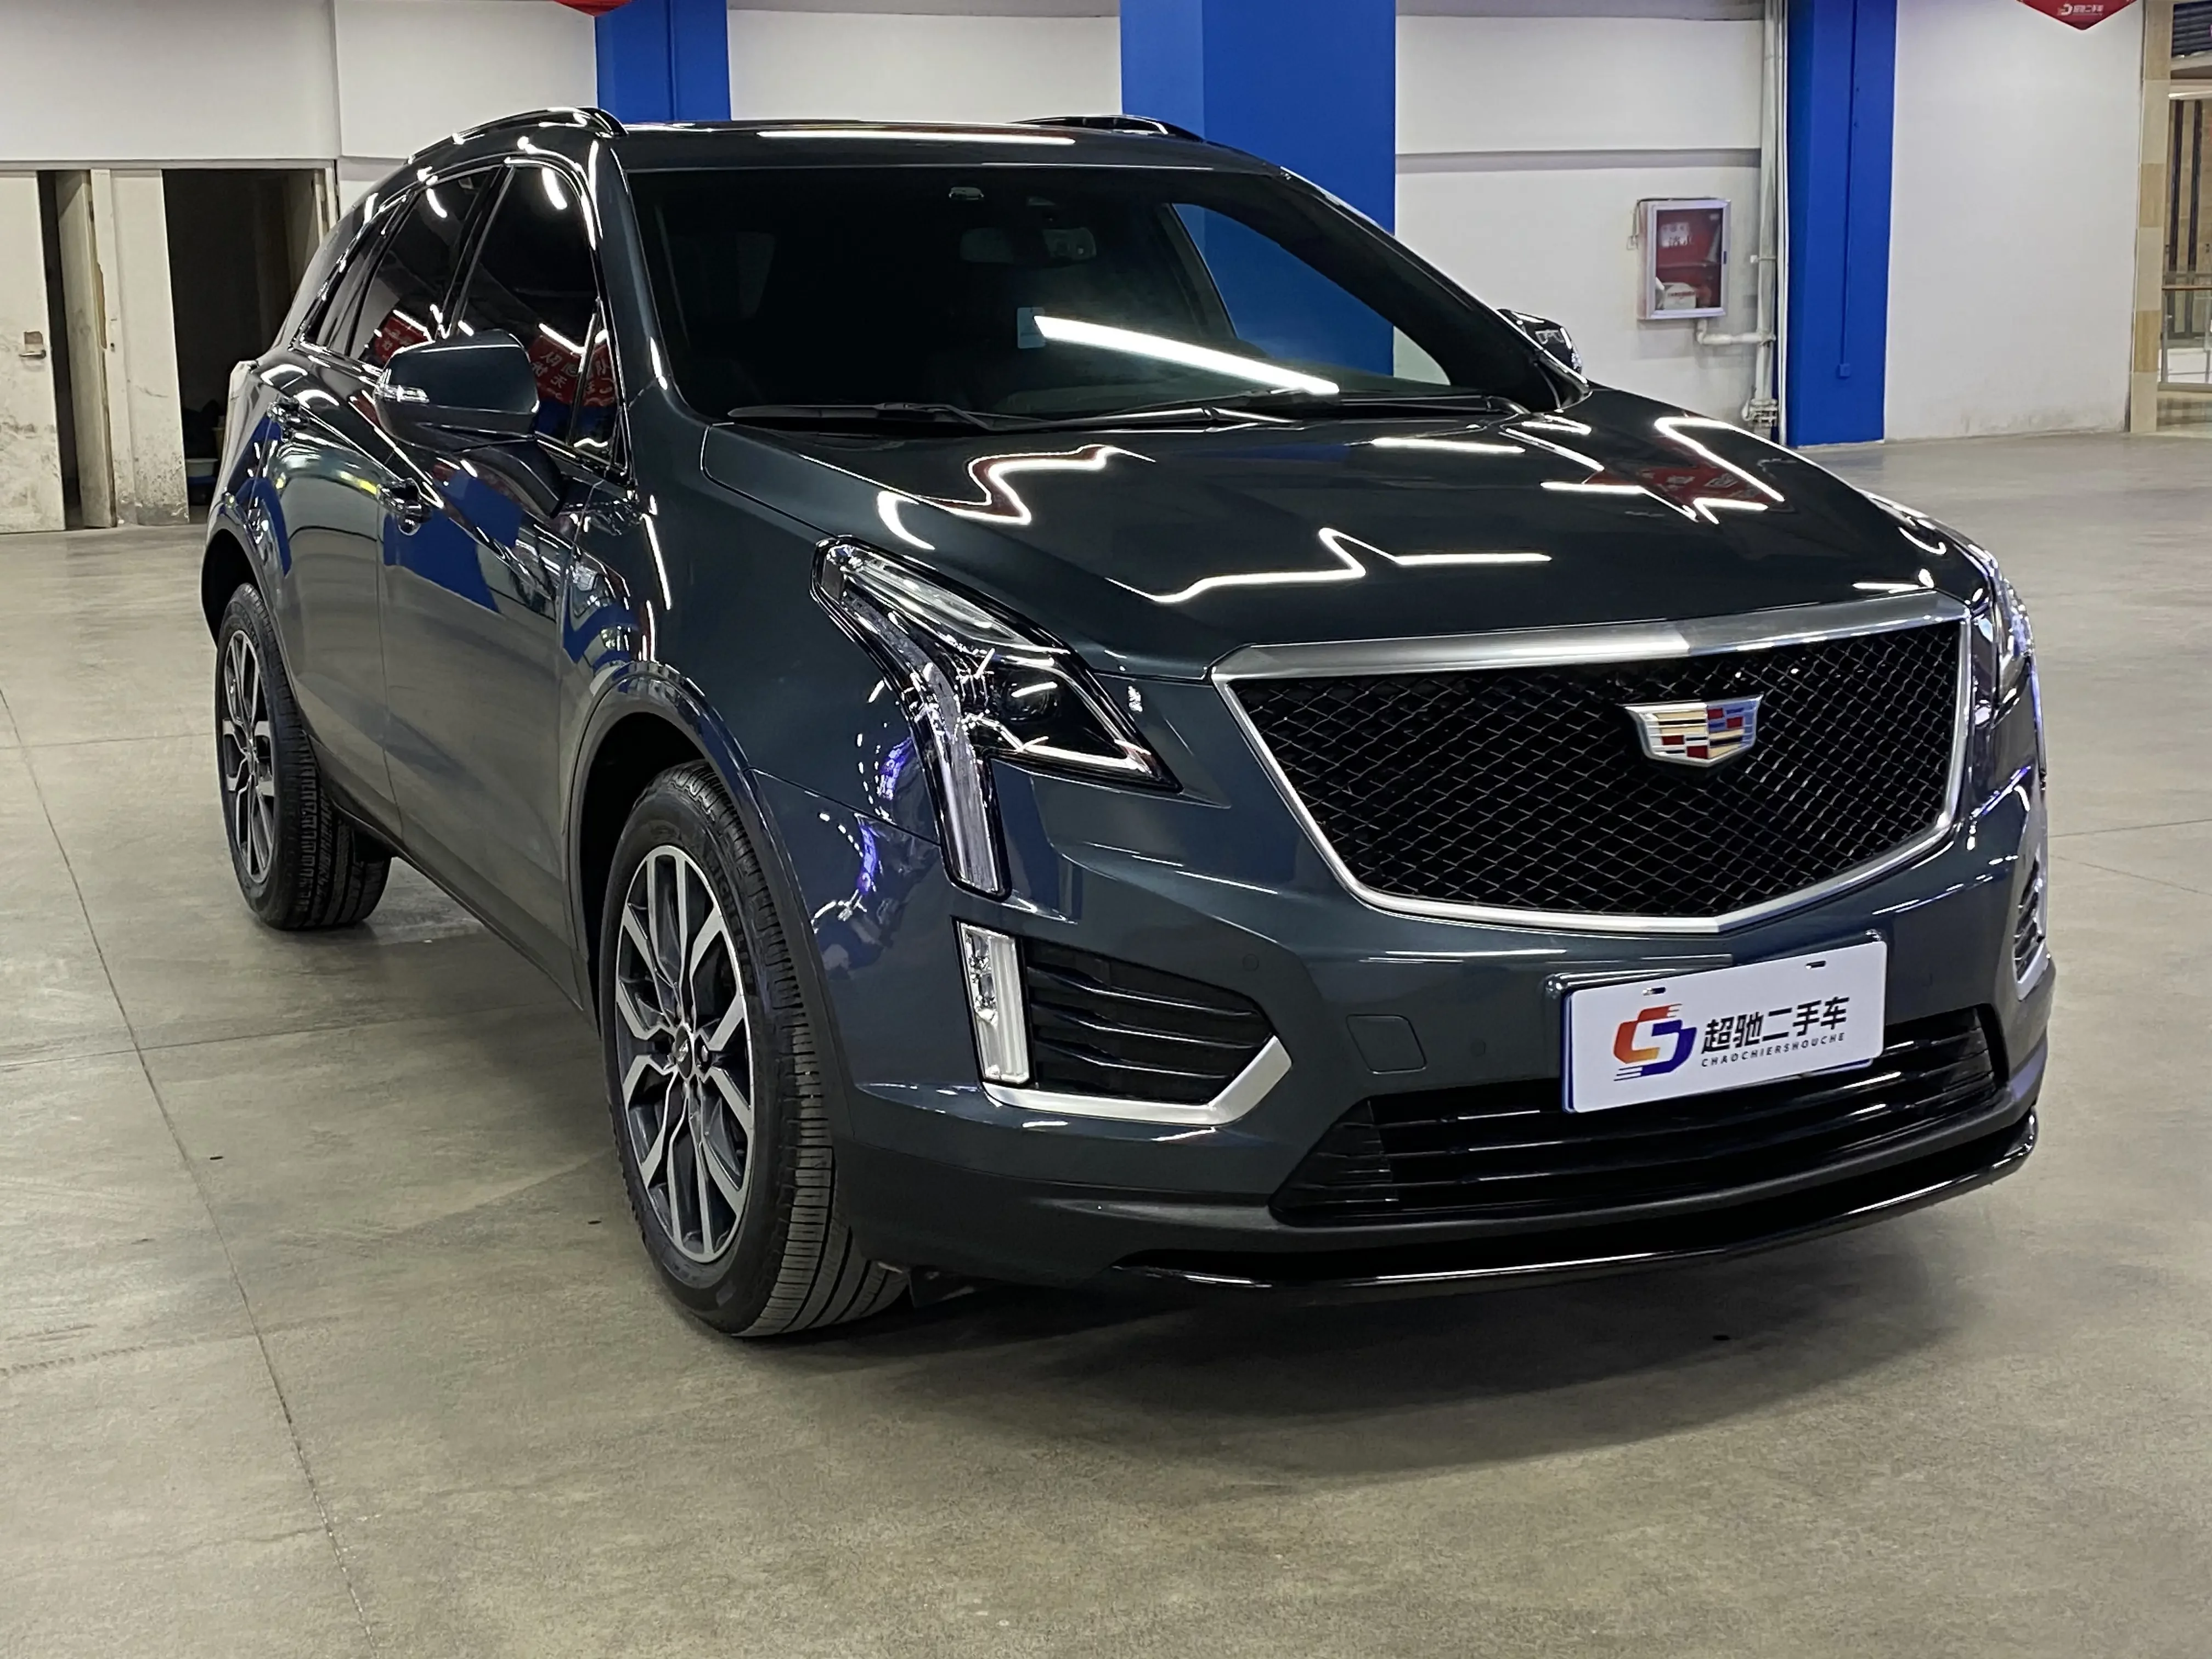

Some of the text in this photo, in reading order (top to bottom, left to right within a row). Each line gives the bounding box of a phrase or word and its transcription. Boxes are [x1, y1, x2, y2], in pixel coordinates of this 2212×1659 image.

[706, 849, 753, 985] MICHELIN
[1701, 996, 1850, 1054] 超驰二手车
[1701, 1032, 1845, 1068] CHAOCHIERSHOUCHE
